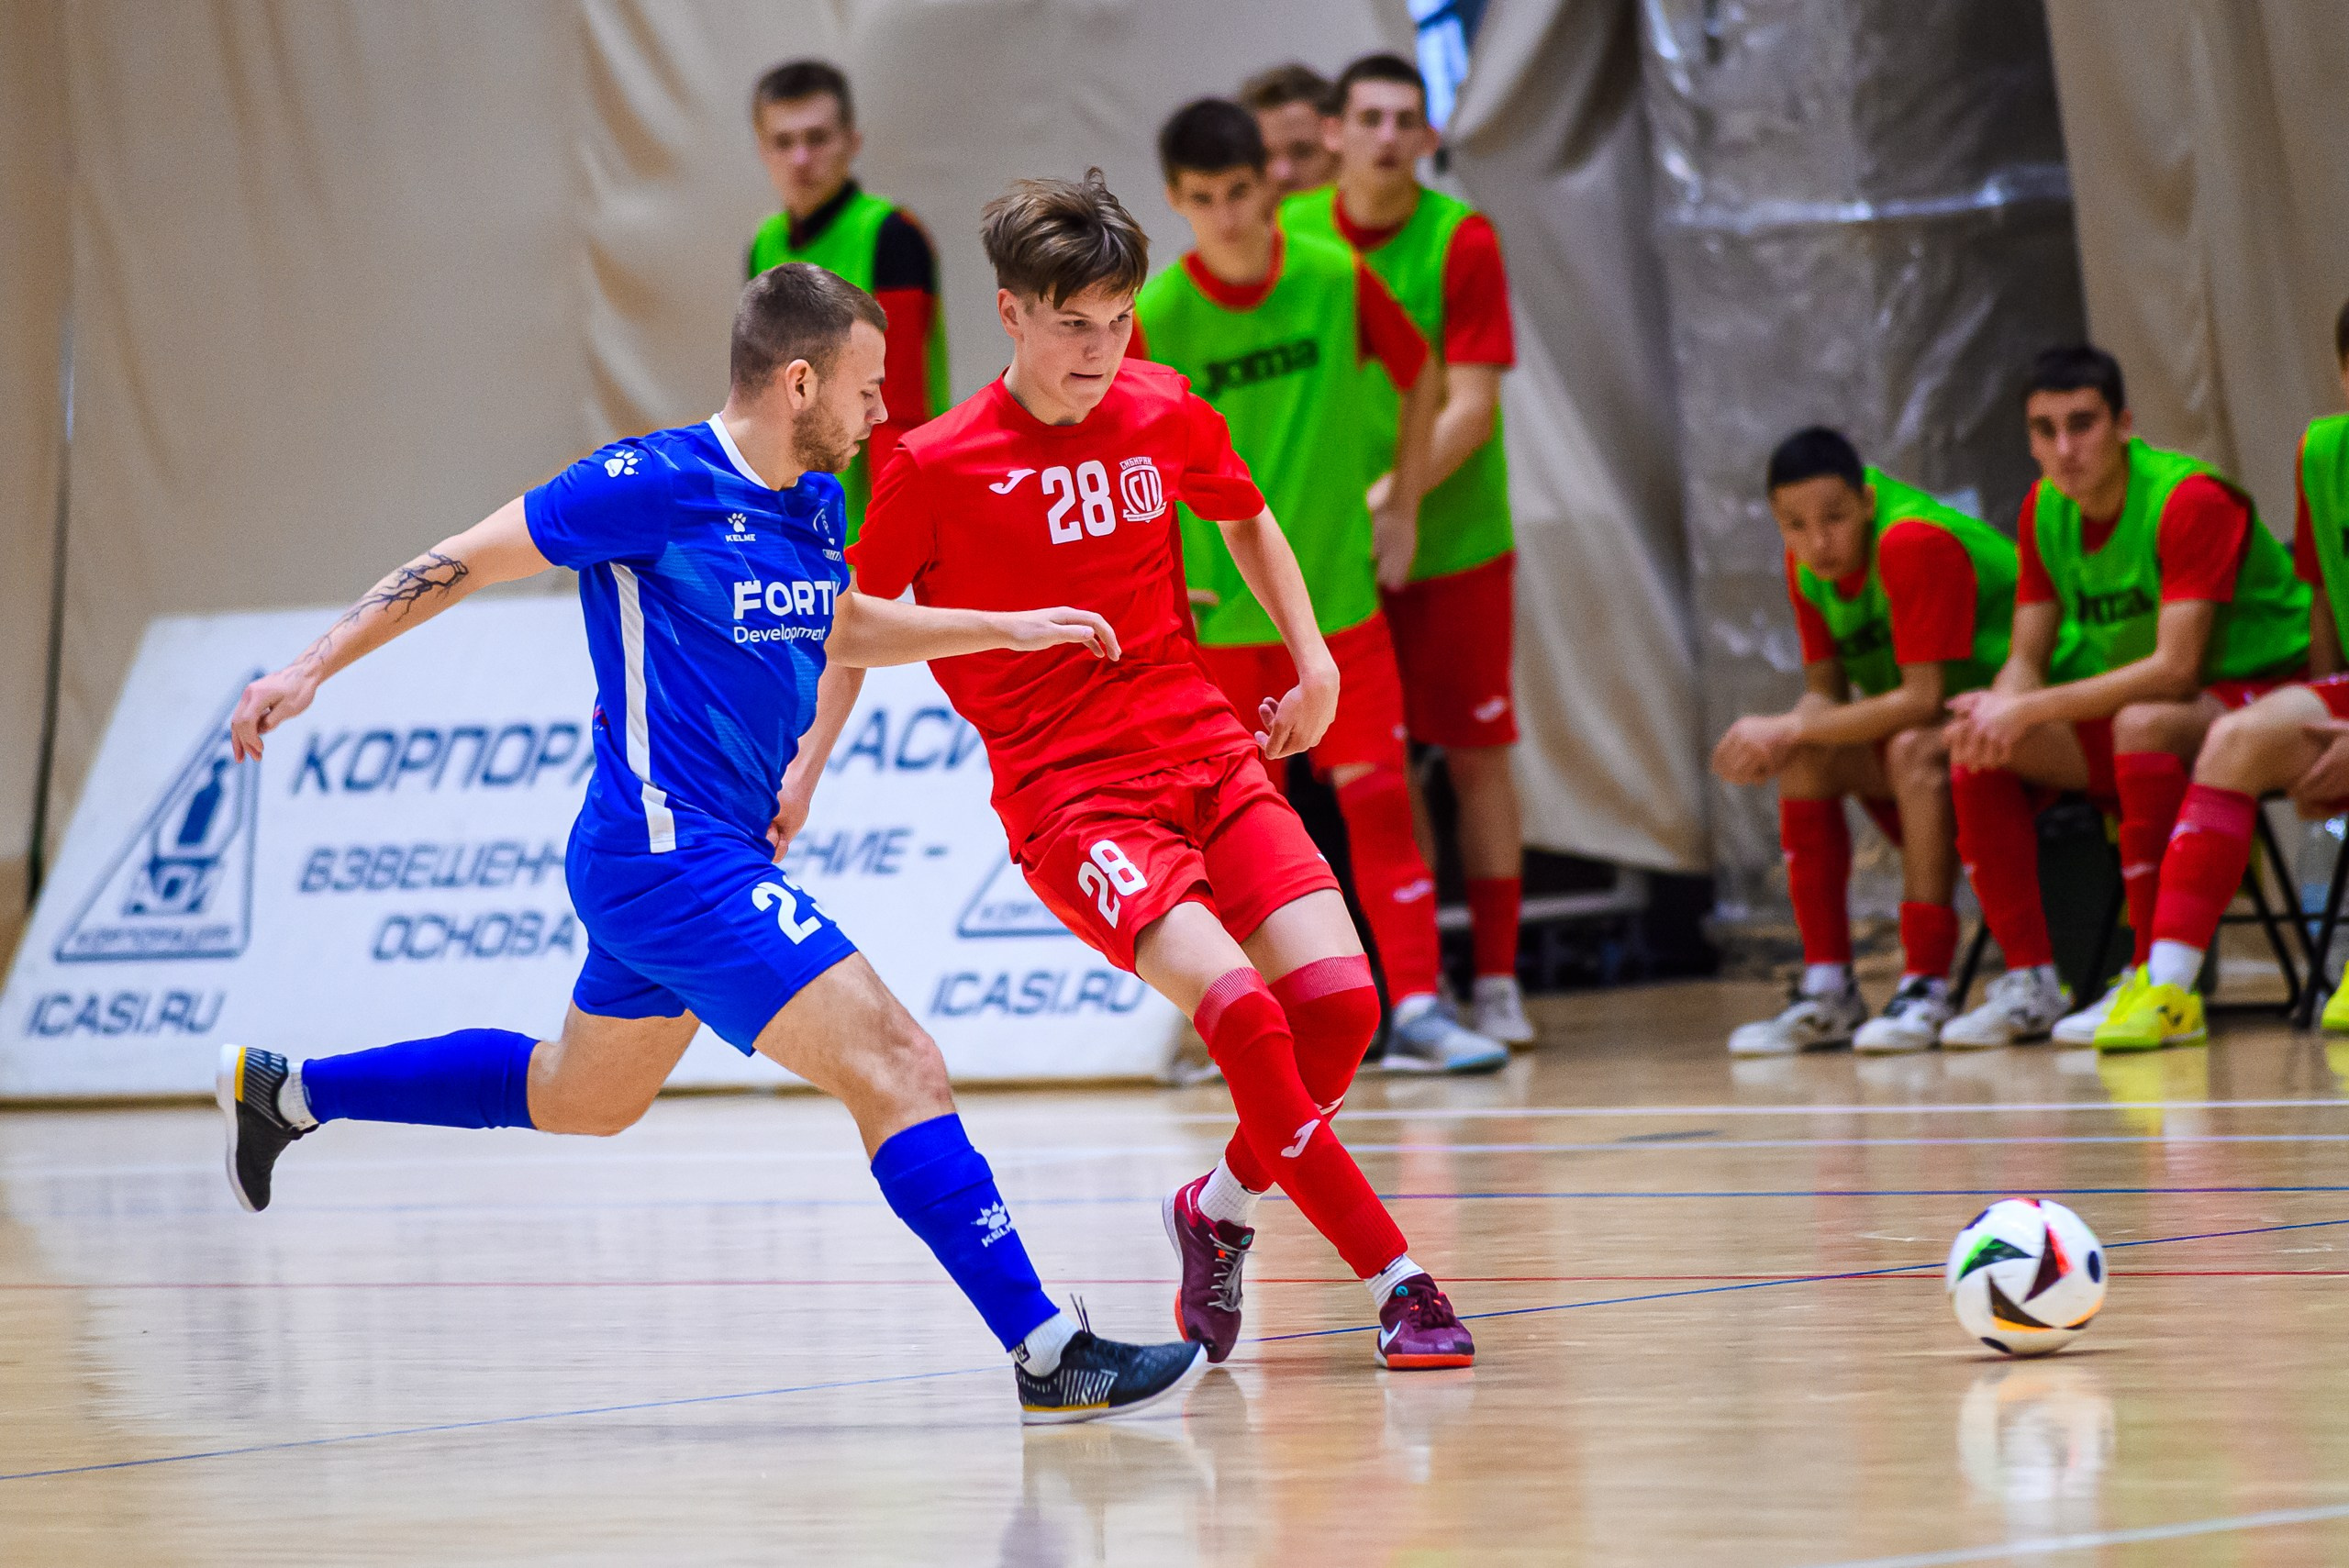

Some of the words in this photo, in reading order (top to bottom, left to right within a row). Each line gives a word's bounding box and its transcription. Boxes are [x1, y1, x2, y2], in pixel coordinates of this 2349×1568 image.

[1041, 460, 1117, 545] 28
[725, 533, 757, 542] KELME
[733, 623, 826, 644] Development
[1077, 839, 1148, 929] 28
[751, 874, 837, 945] 2
[371, 911, 579, 962] ОСНОВА
[26, 988, 227, 1037] ICASI.RU
[930, 968, 1147, 1016] ICASI.RU
